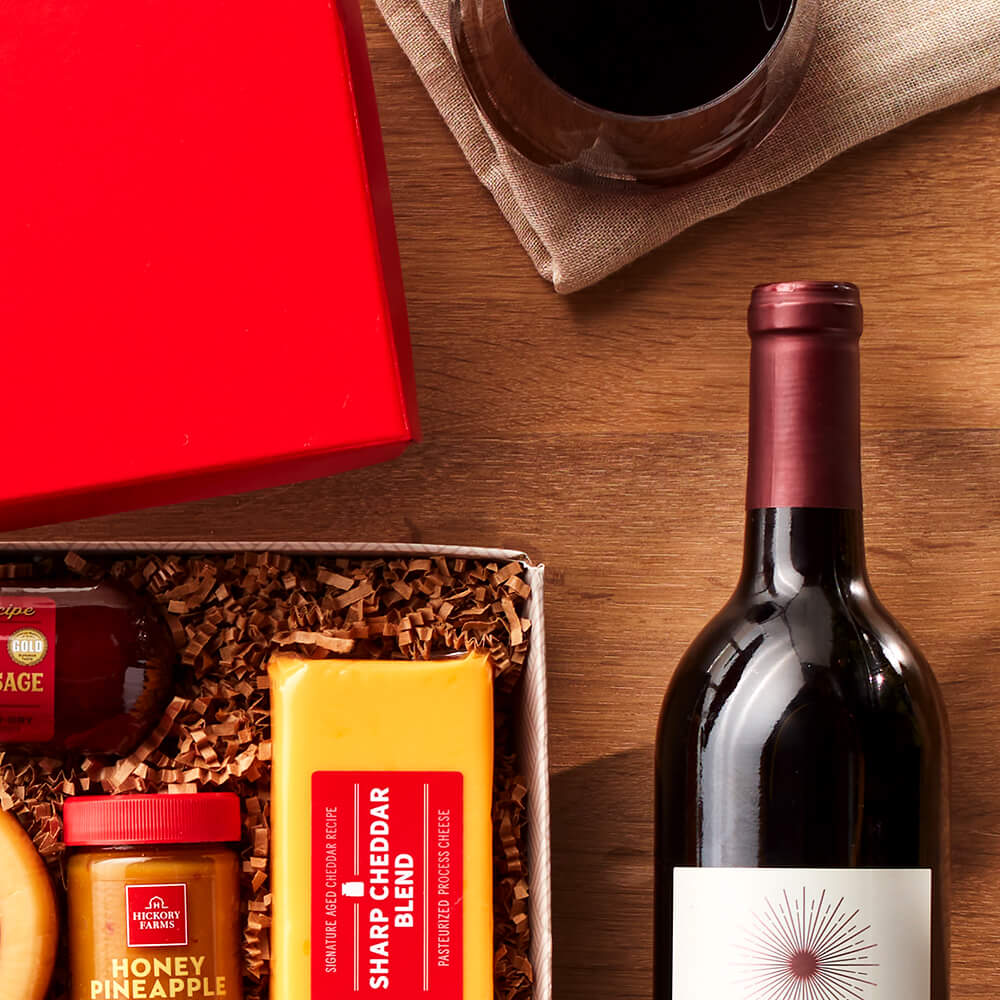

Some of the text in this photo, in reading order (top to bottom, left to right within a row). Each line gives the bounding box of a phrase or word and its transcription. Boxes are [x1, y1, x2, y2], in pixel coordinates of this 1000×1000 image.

[12, 639, 43, 653] GOLD
[325, 806, 337, 973] SIGNATURE AGED CHEDDAR RECIPE
[369, 787, 390, 989] SHARP CHEDDAR
[394, 853, 414, 927] BLEND
[438, 809, 450, 967] PASTEURIZED PROCESS CHEESE
[133, 911, 180, 921] HICKORY
[140, 921, 175, 930] FARMS
[112, 956, 205, 978] HONEY
[90, 976, 226, 1000] PINEAPPLE
